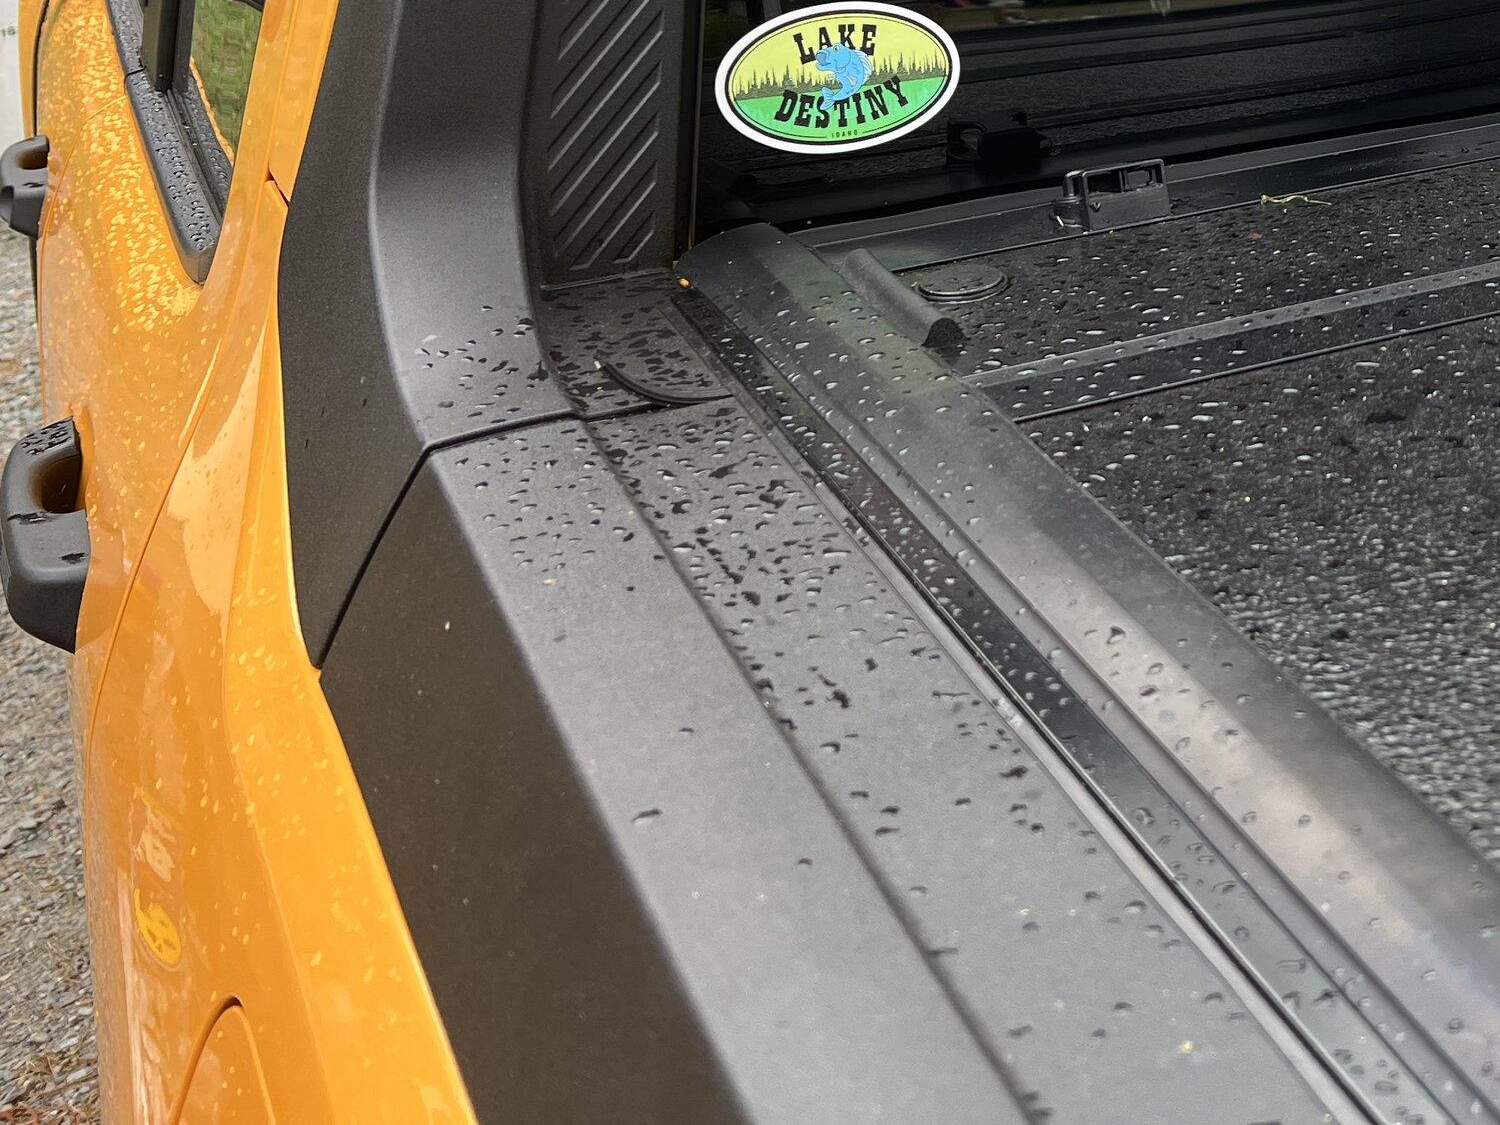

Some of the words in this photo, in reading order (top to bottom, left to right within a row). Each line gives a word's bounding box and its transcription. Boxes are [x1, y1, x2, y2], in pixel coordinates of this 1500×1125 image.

[793, 23, 877, 64] LAKE
[774, 75, 908, 129] DESTINY
[831, 129, 859, 139] IDAHO
